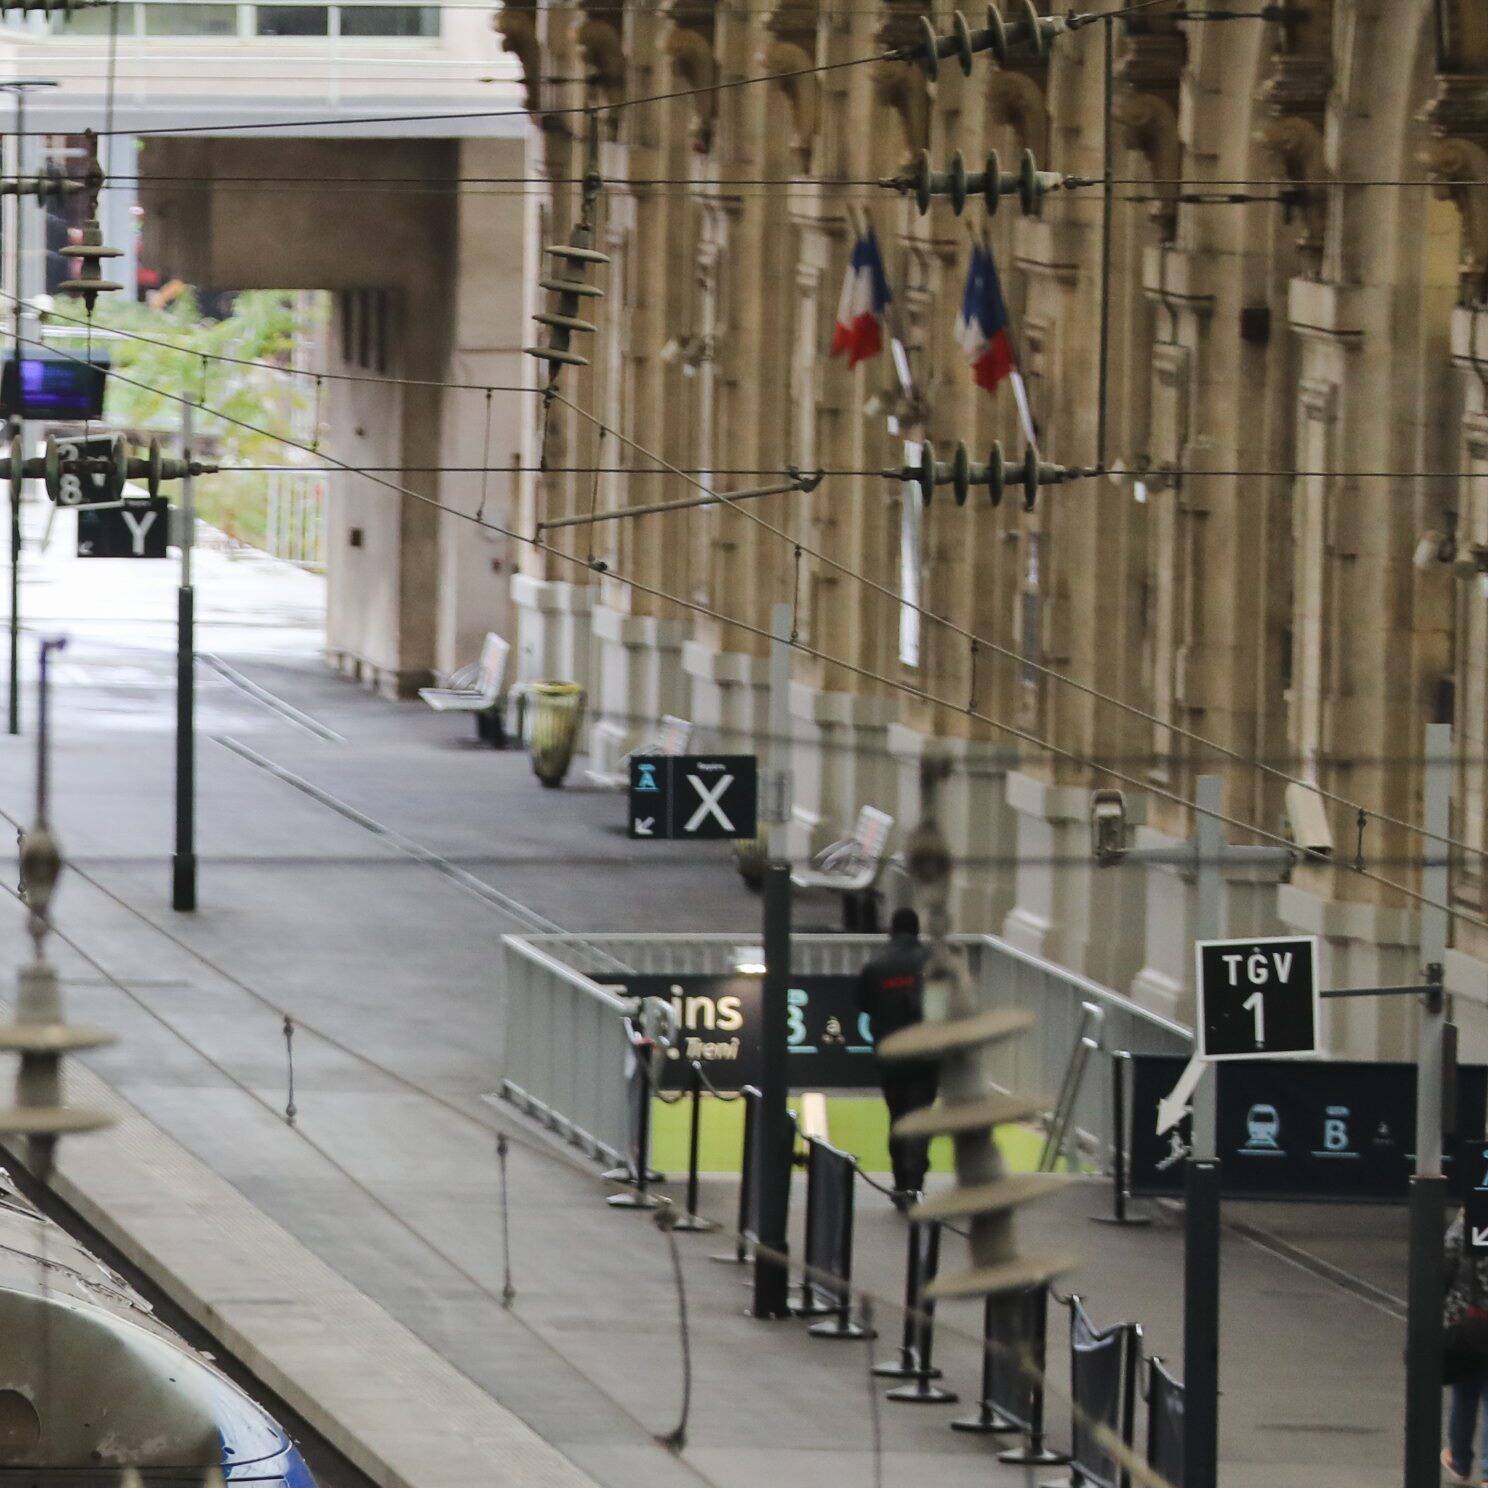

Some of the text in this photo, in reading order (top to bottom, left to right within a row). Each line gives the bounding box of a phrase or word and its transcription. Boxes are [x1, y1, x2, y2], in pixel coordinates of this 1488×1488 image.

[121, 511, 158, 555] Y
[638, 772, 656, 788] A
[684, 774, 736, 832] X
[1221, 951, 1293, 986] TGV
[1242, 992, 1266, 1044] 1
[1325, 1119, 1349, 1150] B
